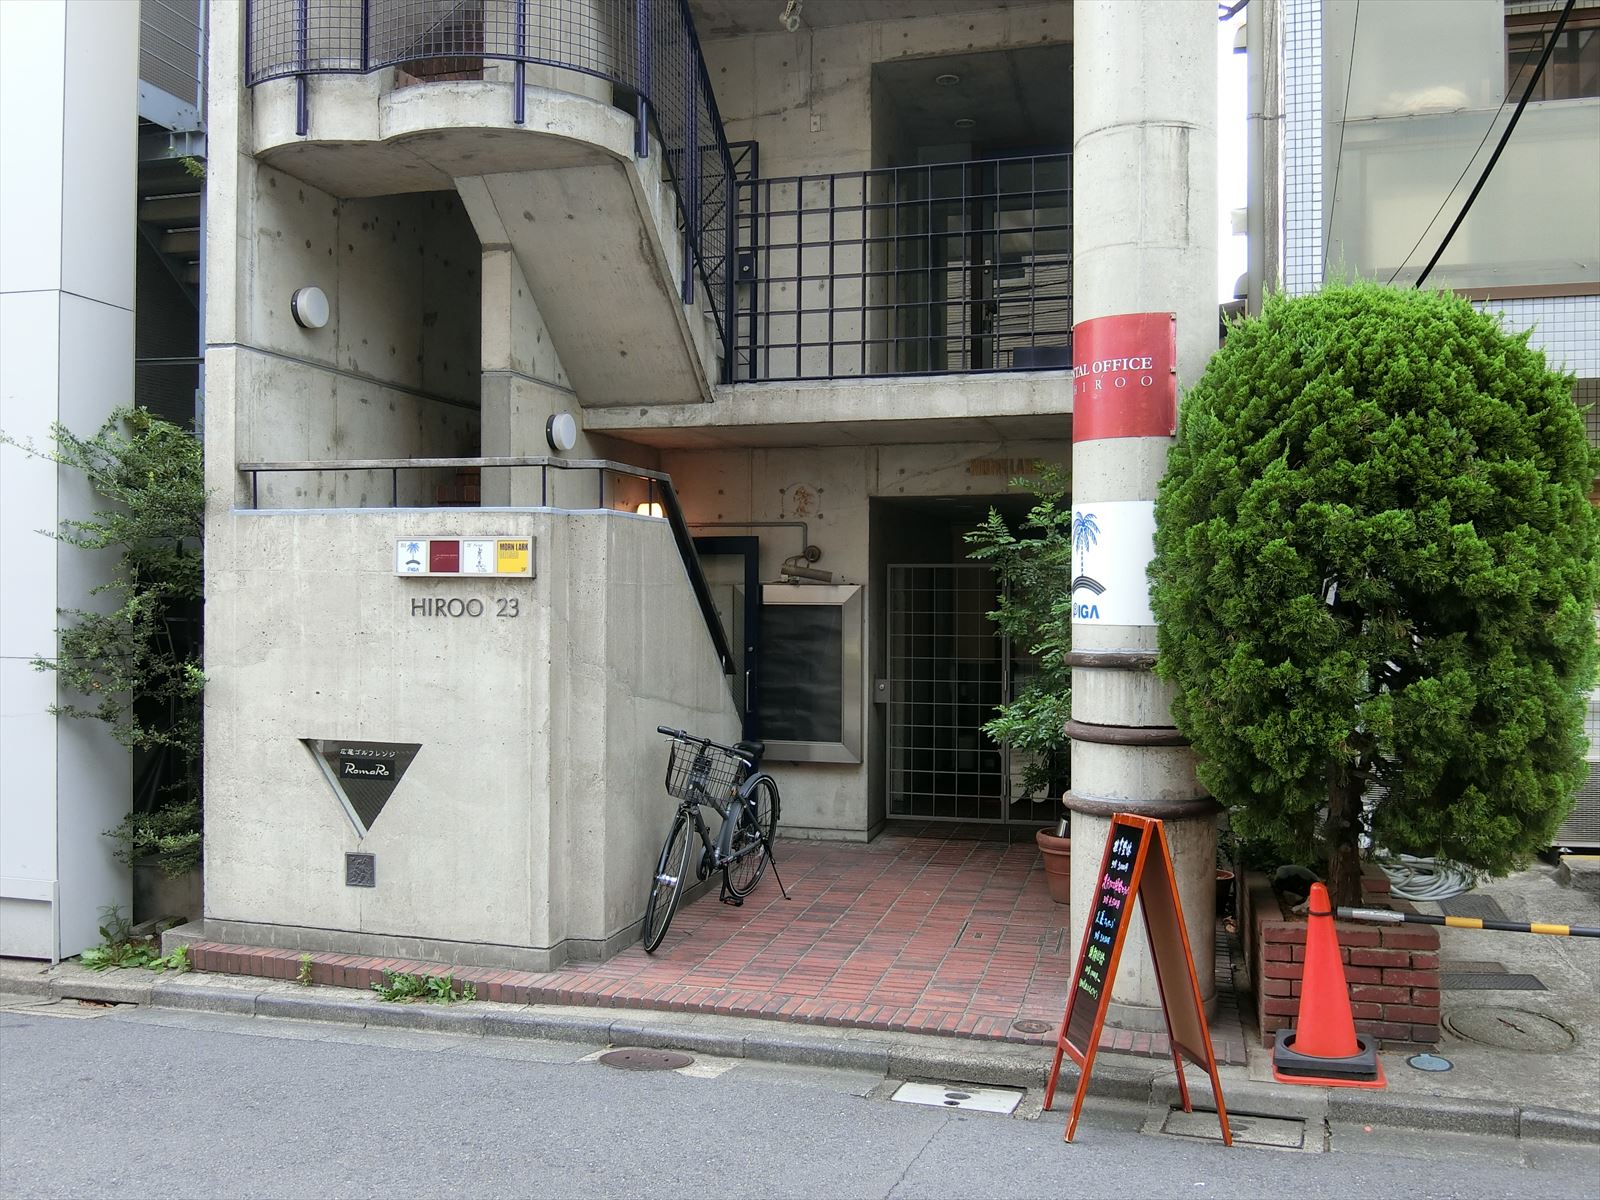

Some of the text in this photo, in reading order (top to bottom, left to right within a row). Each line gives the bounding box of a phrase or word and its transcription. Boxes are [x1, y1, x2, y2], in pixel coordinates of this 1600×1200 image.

[1092, 357, 1153, 375] OFFICE
[410, 597, 519, 618] HIROO 23
[340, 748, 396, 758] 広尾ゴルフレンジ
[344, 762, 390, 776] RomaRo
